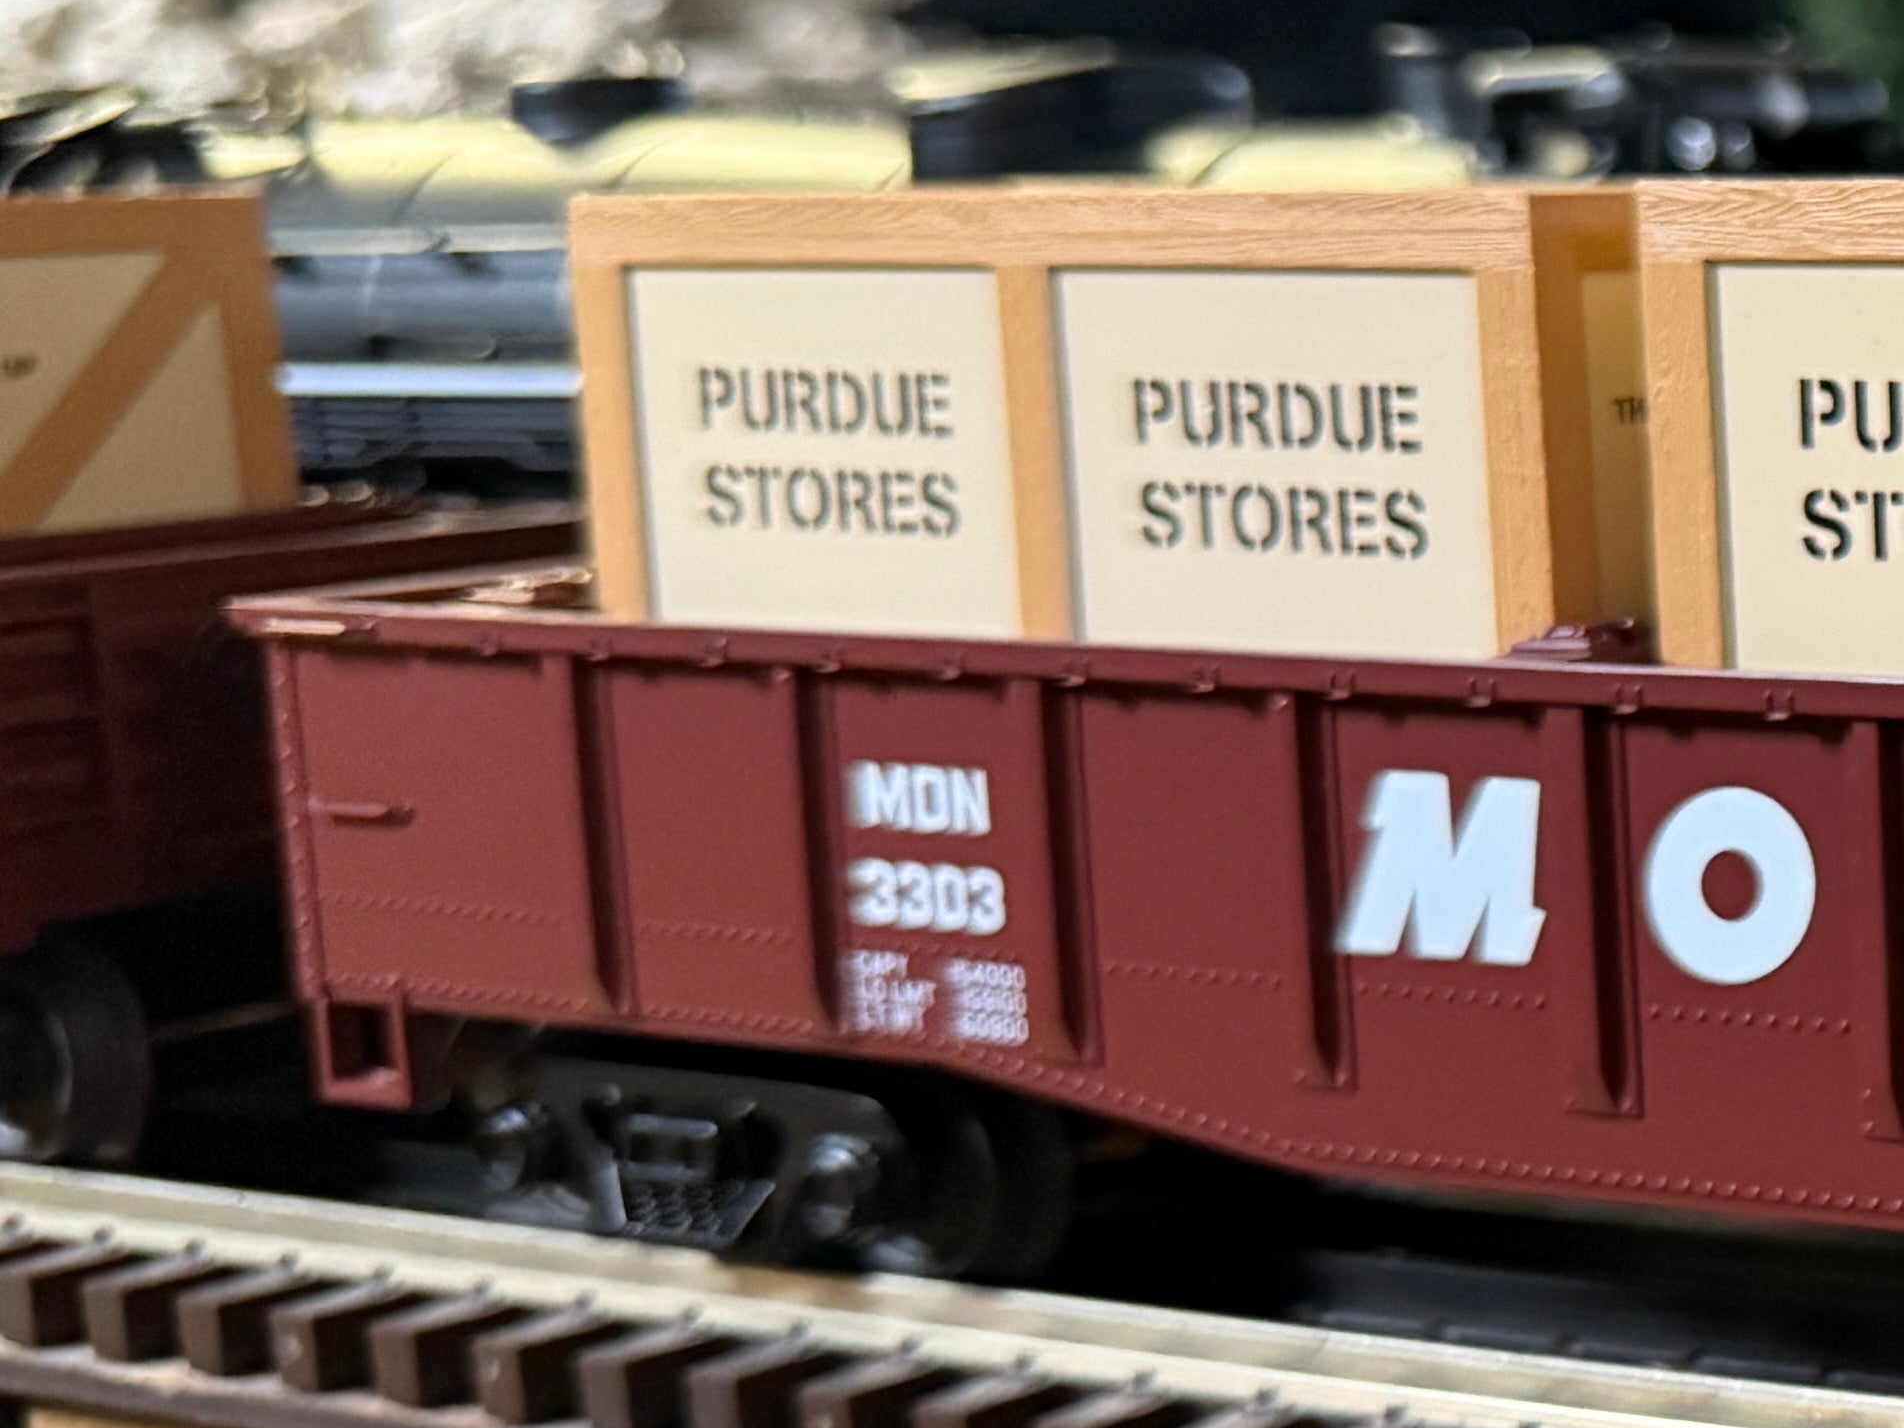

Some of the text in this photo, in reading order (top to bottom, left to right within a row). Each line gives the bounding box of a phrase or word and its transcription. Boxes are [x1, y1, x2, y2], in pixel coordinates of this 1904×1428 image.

[697, 368, 952, 438] PURDUE
[1131, 377, 1423, 454] PURDUE
[704, 465, 960, 537] STORES
[1139, 480, 1428, 560] STORES
[845, 760, 991, 836] MON
[848, 858, 1006, 935] 3303
